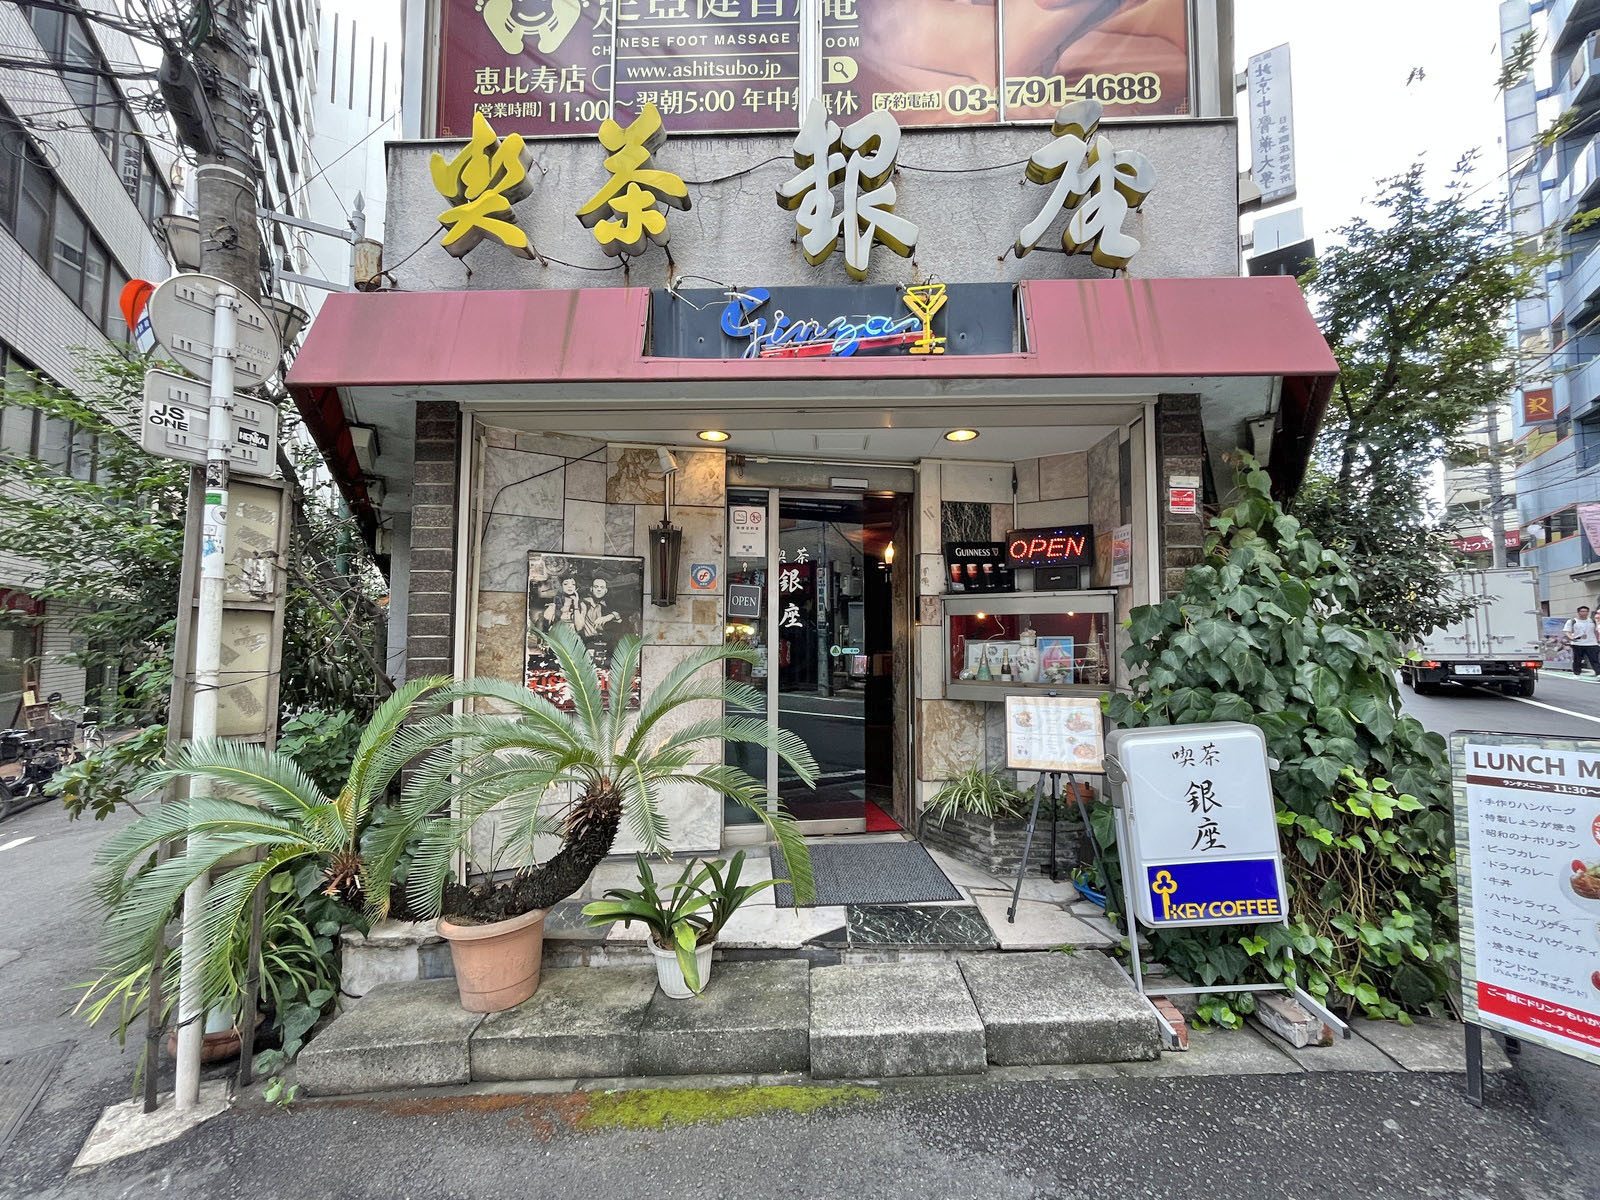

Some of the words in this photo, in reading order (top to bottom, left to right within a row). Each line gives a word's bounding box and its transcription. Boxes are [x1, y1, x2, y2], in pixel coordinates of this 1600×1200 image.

[592, 36, 660, 57] CHNESE
[667, 35, 708, 47] FOOT
[714, 32, 790, 45] MASSAGE
[797, 33, 859, 48] OOM
[473, 64, 587, 95] 恵比寿店
[627, 60, 781, 79] www.ashitsubo.jp
[948, 75, 1159, 112] 03-791-4688
[721, 287, 923, 358] Ginza
[149, 415, 189, 432] ONE
[154, 404, 185, 420] JS
[955, 547, 991, 557] GUINNESS
[1009, 536, 1085, 559] OPEN
[731, 595, 757, 607] OPEN
[1171, 742, 1221, 768] 喫茶
[1473, 751, 1565, 776] LUNCH
[1502, 779, 1551, 790] ランチメニュー
[1184, 779, 1227, 852] 銀座
[1169, 903, 1208, 919] KEY
[1209, 899, 1280, 917] COFFEE
